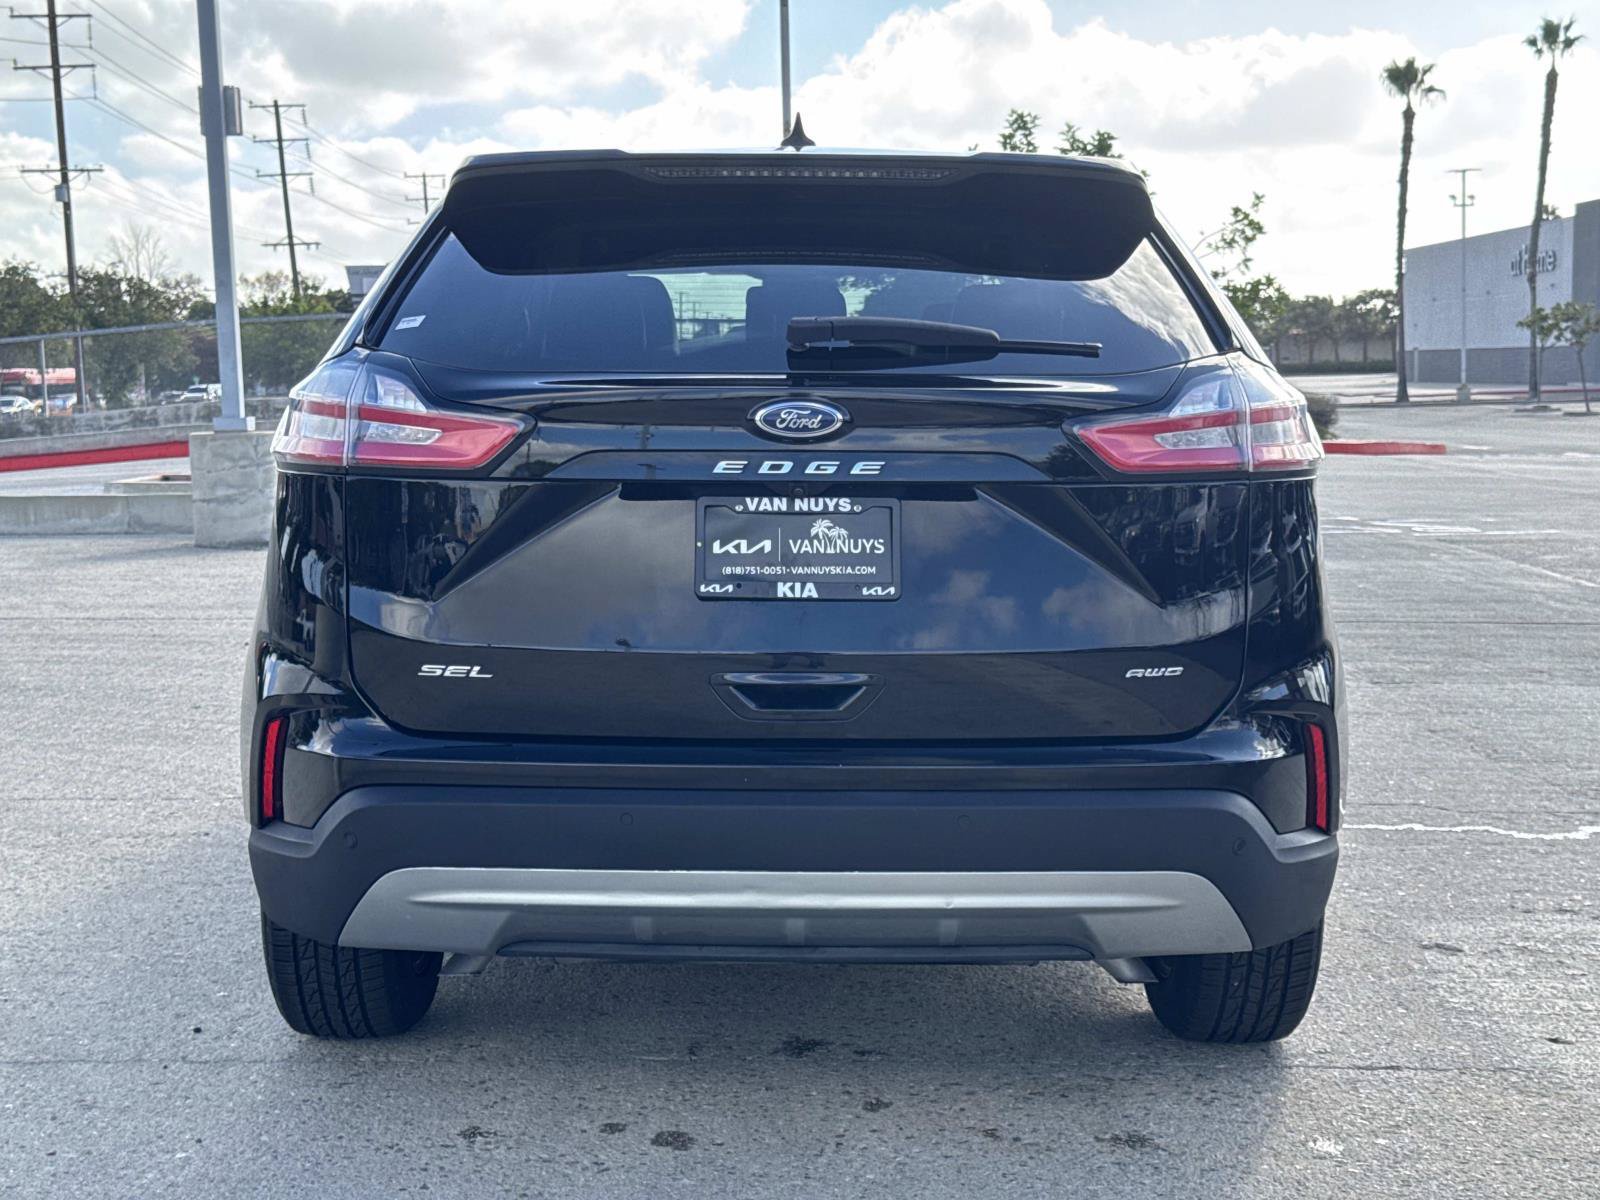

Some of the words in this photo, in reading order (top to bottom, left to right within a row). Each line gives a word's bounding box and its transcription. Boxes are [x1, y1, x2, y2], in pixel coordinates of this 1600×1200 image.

[775, 408, 822, 429] Ford
[711, 460, 887, 475] EDGE
[745, 497, 787, 512] VAN
[794, 497, 852, 512] NUYS
[777, 582, 819, 598] KIA
[417, 664, 494, 678] SEL
[1125, 666, 1185, 678] AWD
